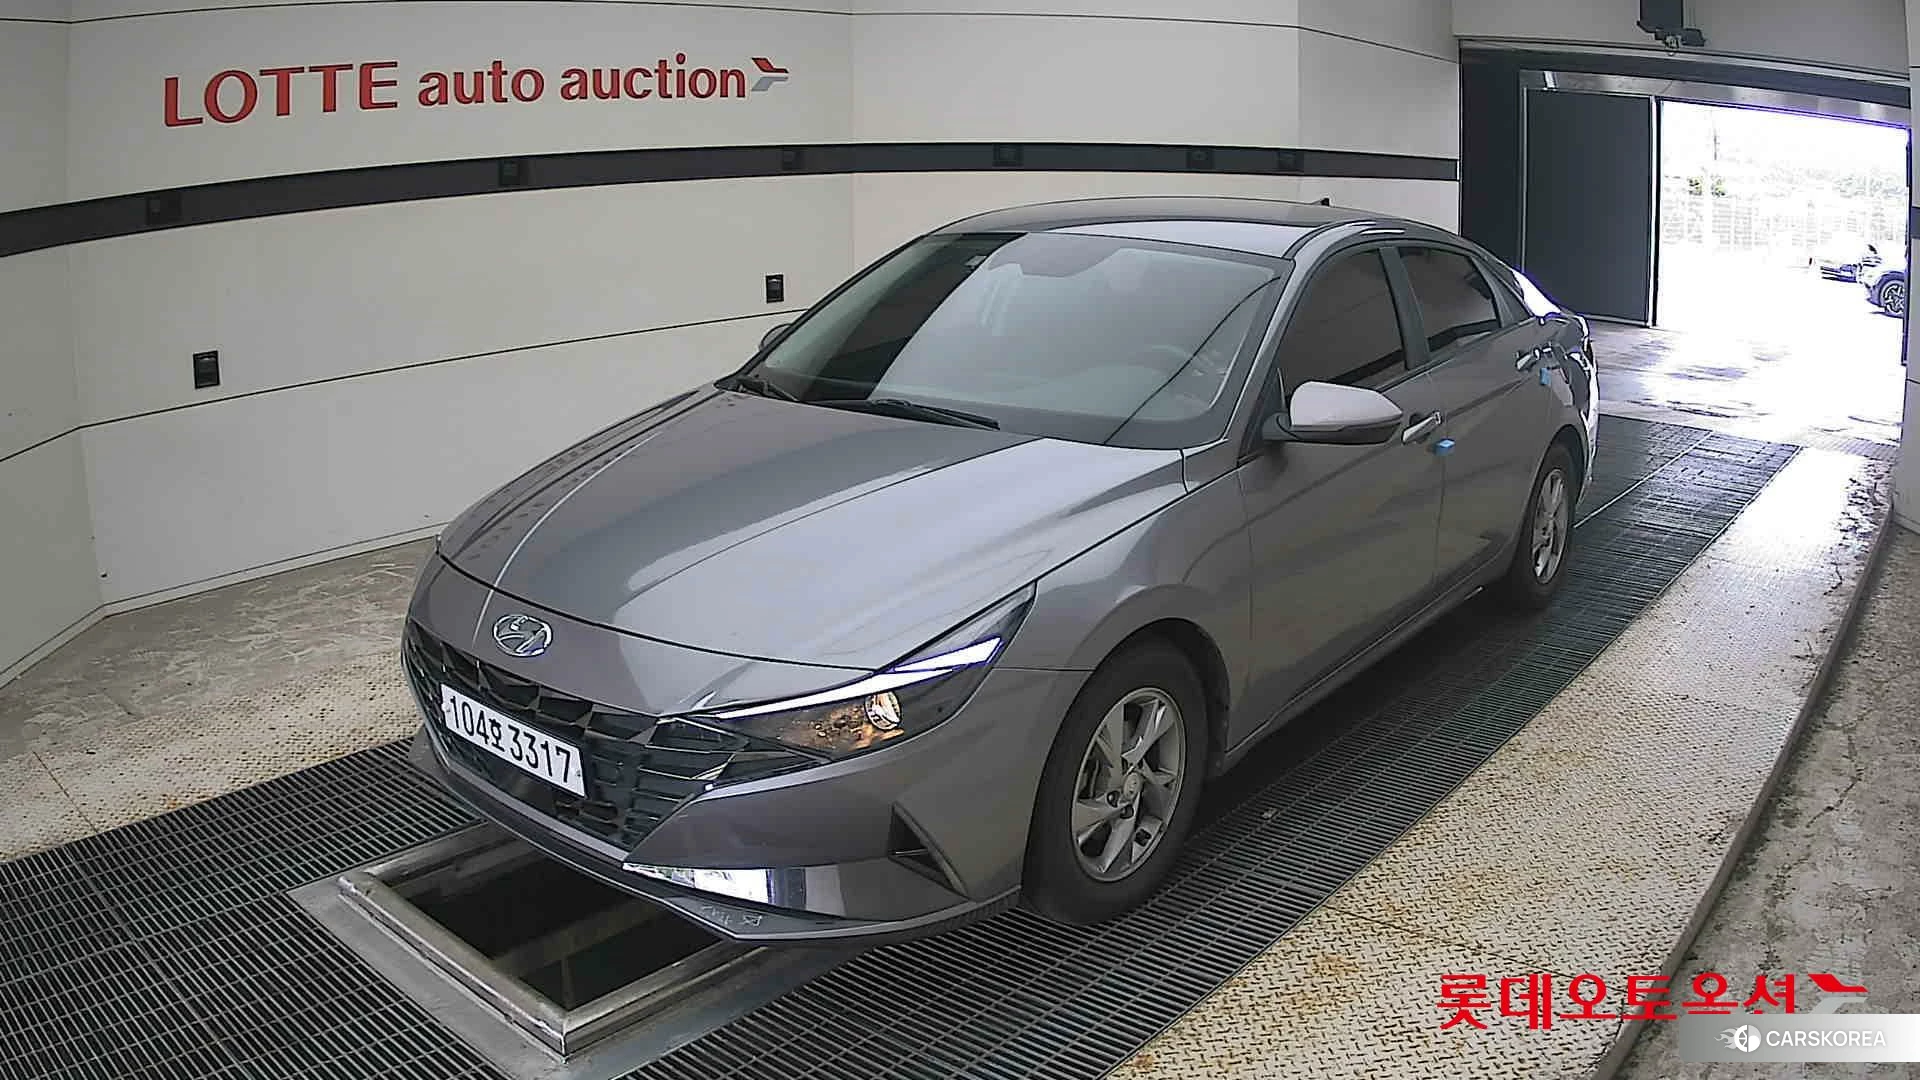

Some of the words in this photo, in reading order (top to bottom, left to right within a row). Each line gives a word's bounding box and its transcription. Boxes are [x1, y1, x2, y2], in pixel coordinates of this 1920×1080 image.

[163, 60, 399, 128] LOTTE
[417, 59, 546, 107] auto
[559, 52, 748, 101] auction
[508, 724, 571, 784] 3317
